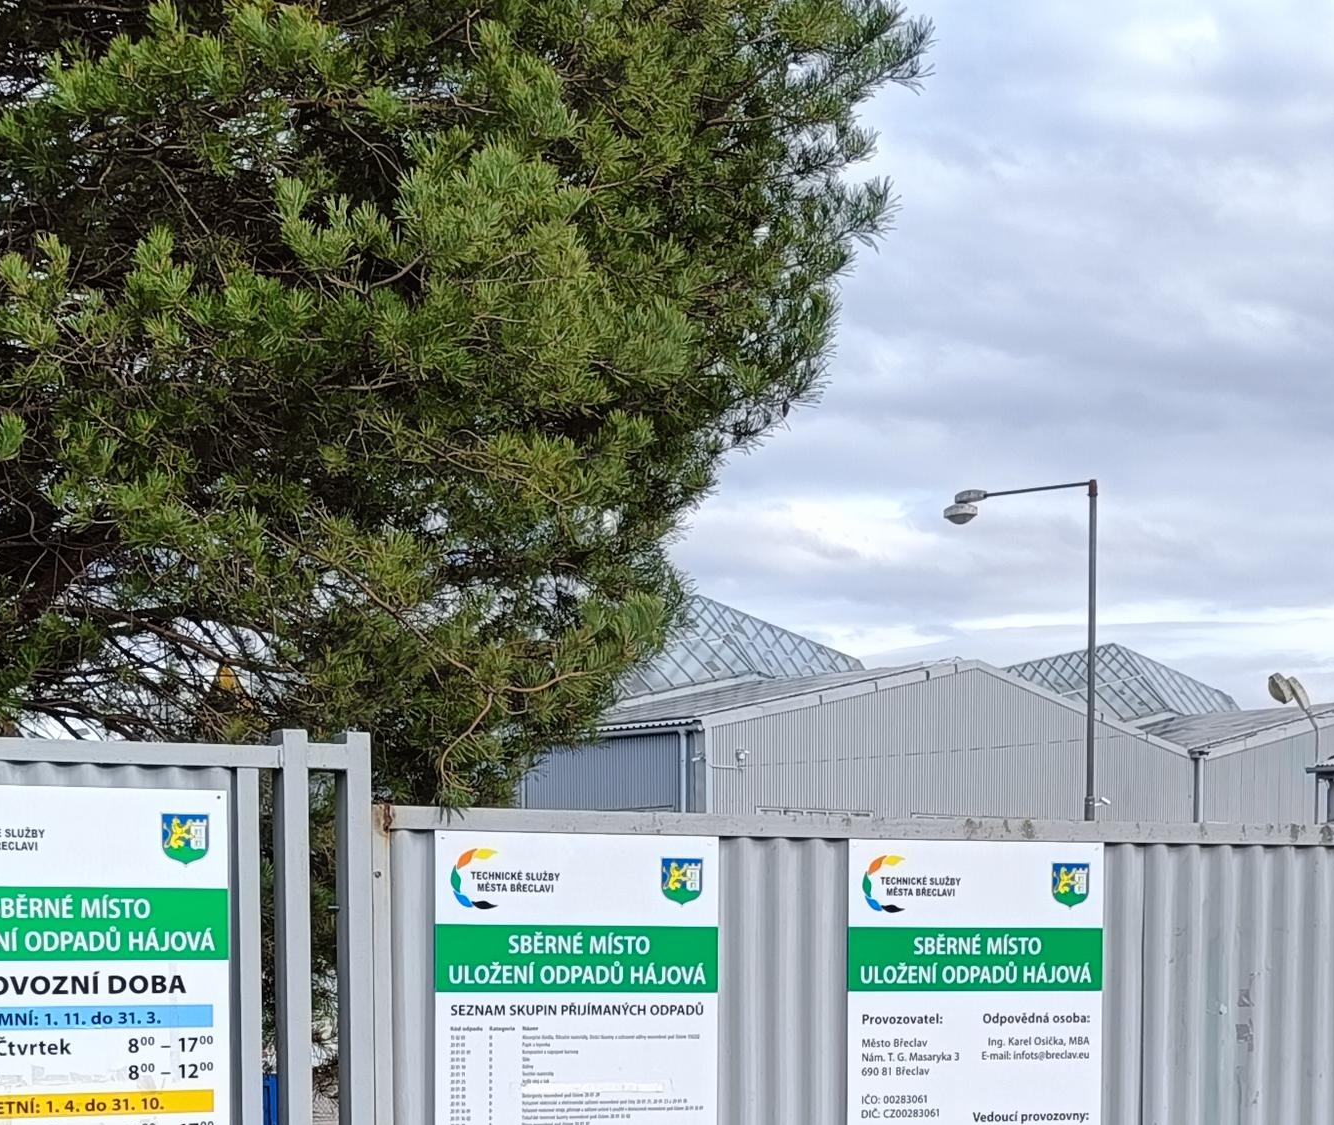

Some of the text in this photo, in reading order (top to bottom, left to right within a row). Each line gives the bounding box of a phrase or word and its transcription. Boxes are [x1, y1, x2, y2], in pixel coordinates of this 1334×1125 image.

[5, 827, 44, 838] SLUŽBY
[471, 871, 560, 881] TECHNICKÉ SLUŽBY
[478, 882, 553, 892] MĚSTA BŘECLAVI
[81, 895, 150, 918] MÍSTO
[25, 926, 120, 951] ODPADŮ
[129, 928, 215, 951] HÁJOVÁ
[509, 932, 650, 954] SBĚRNÉ MÍSTO
[914, 934, 1041, 955] SBĚRNÉ MÍSTO
[449, 961, 706, 984] ULOŽENÍ ODPADŮ HÁJOVÁ
[861, 961, 1091, 984] ULOŽENÍ ODPADŮ HÁJOVÁ
[108, 975, 186, 994] DOBA
[451, 1002, 703, 1016] SEZNAM SKUPIN PŘIJÍMANÝCH ODPADŮ
[45, 1013, 58, 1025] 1.
[64, 1013, 86, 1025] 11.
[91, 1012, 112, 1024] do
[118, 1012, 141, 1024] 31.
[147, 1012, 161, 1024] 3.
[862, 1013, 942, 1024] Provozovatel:
[983, 1013, 1090, 1026] Odpovědná osoba:
[862, 1038, 927, 1047] Město Břeclav
[1009, 1037, 1031, 1046] Karel
[1034, 1036, 1066, 1046] Osička,
[1069, 1036, 1089, 1045] MBA
[982, 1050, 1089, 1060] E-mail: infots@breclav.eu
[862, 1066, 929, 1076] 690 81 Břeclav
[883, 1095, 927, 1104] 00283061
[46, 1101, 59, 1116] 1.
[65, 1100, 79, 1112] 4.
[85, 1099, 106, 1111] do
[112, 1099, 135, 1111] 31.
[141, 1098, 164, 1109] 10.
[883, 1109, 939, 1118] CZ00283061
[973, 1111, 1089, 1124] Vedoucí provozovny:
